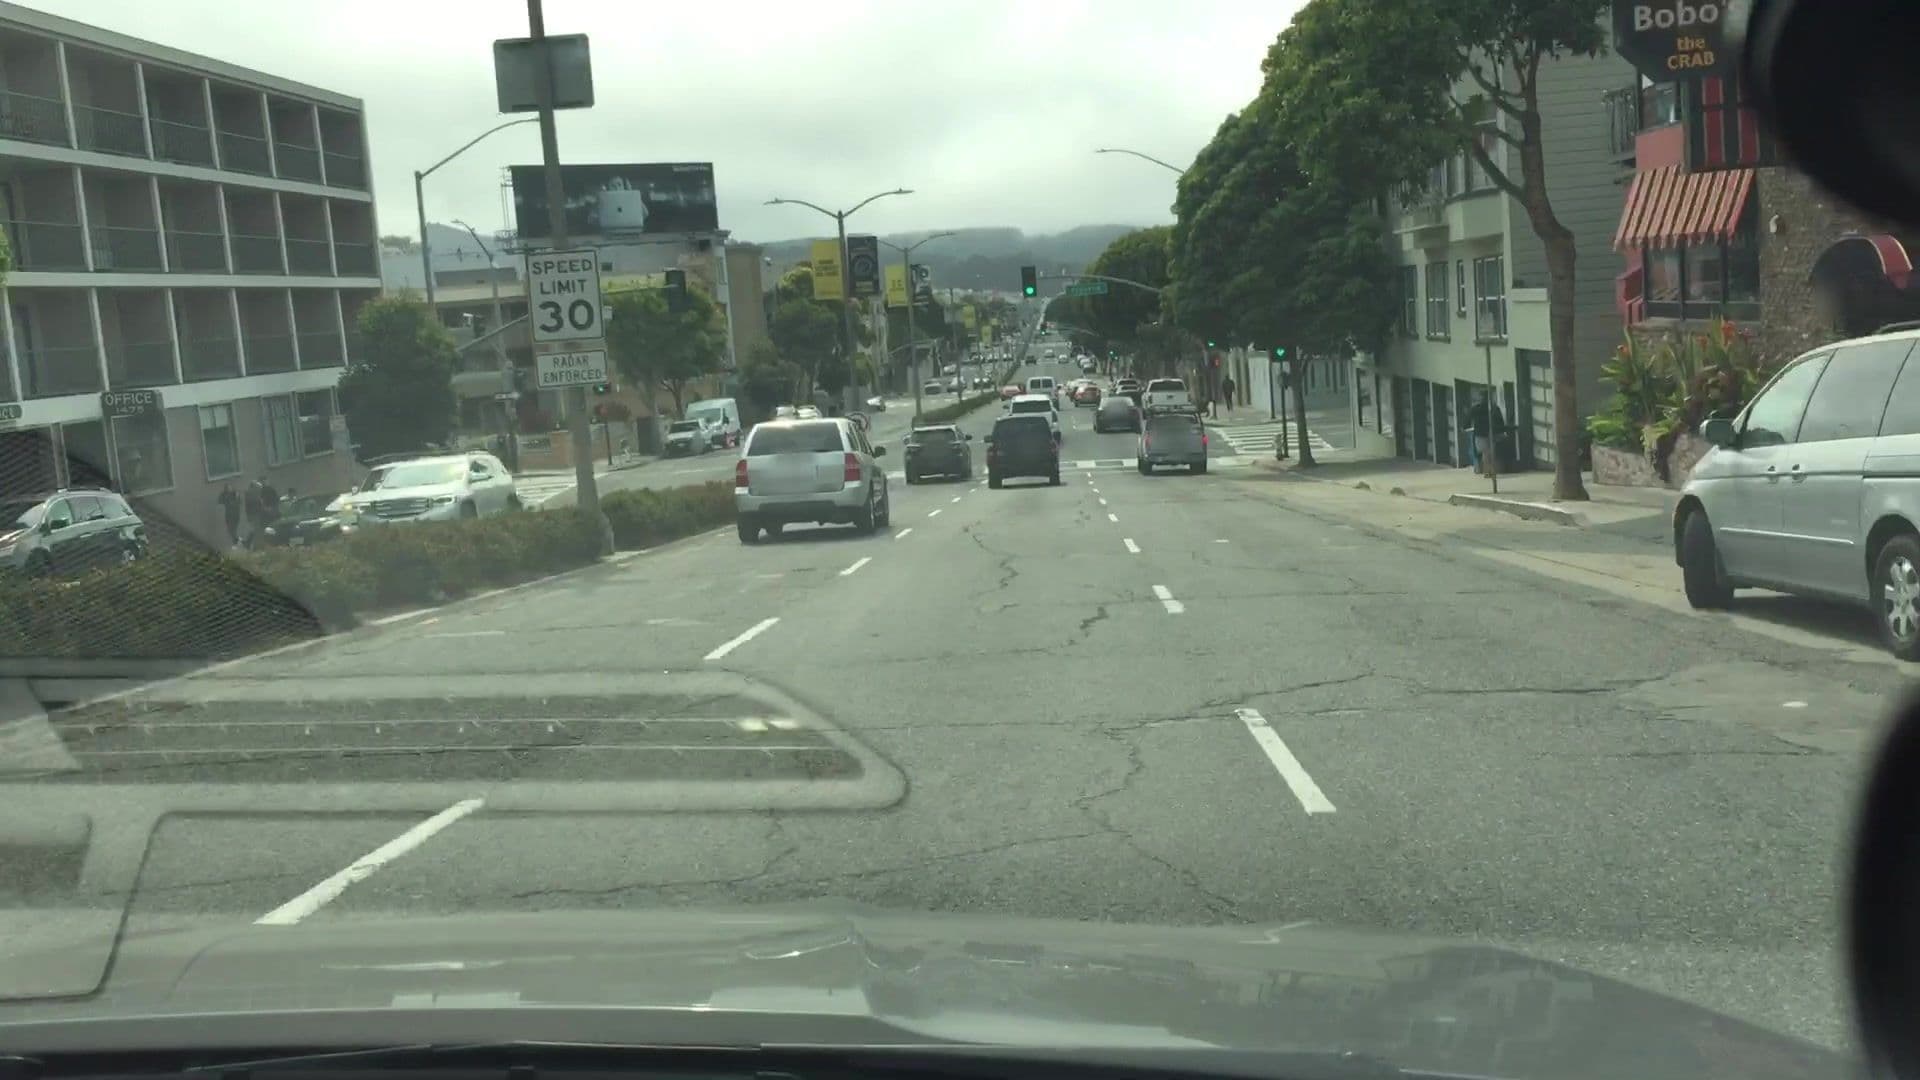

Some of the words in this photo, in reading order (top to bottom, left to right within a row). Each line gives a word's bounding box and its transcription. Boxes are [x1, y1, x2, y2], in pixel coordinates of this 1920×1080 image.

[1676, 36, 1706, 51] the
[1667, 51, 1715, 70] CRAB
[532, 258, 592, 275] SPEED
[540, 279, 587, 295] LIMIT
[538, 299, 595, 333] 30
[553, 355, 590, 368] RADAR
[543, 368, 602, 384] ENFORCED
[105, 391, 153, 406] OFFICE
